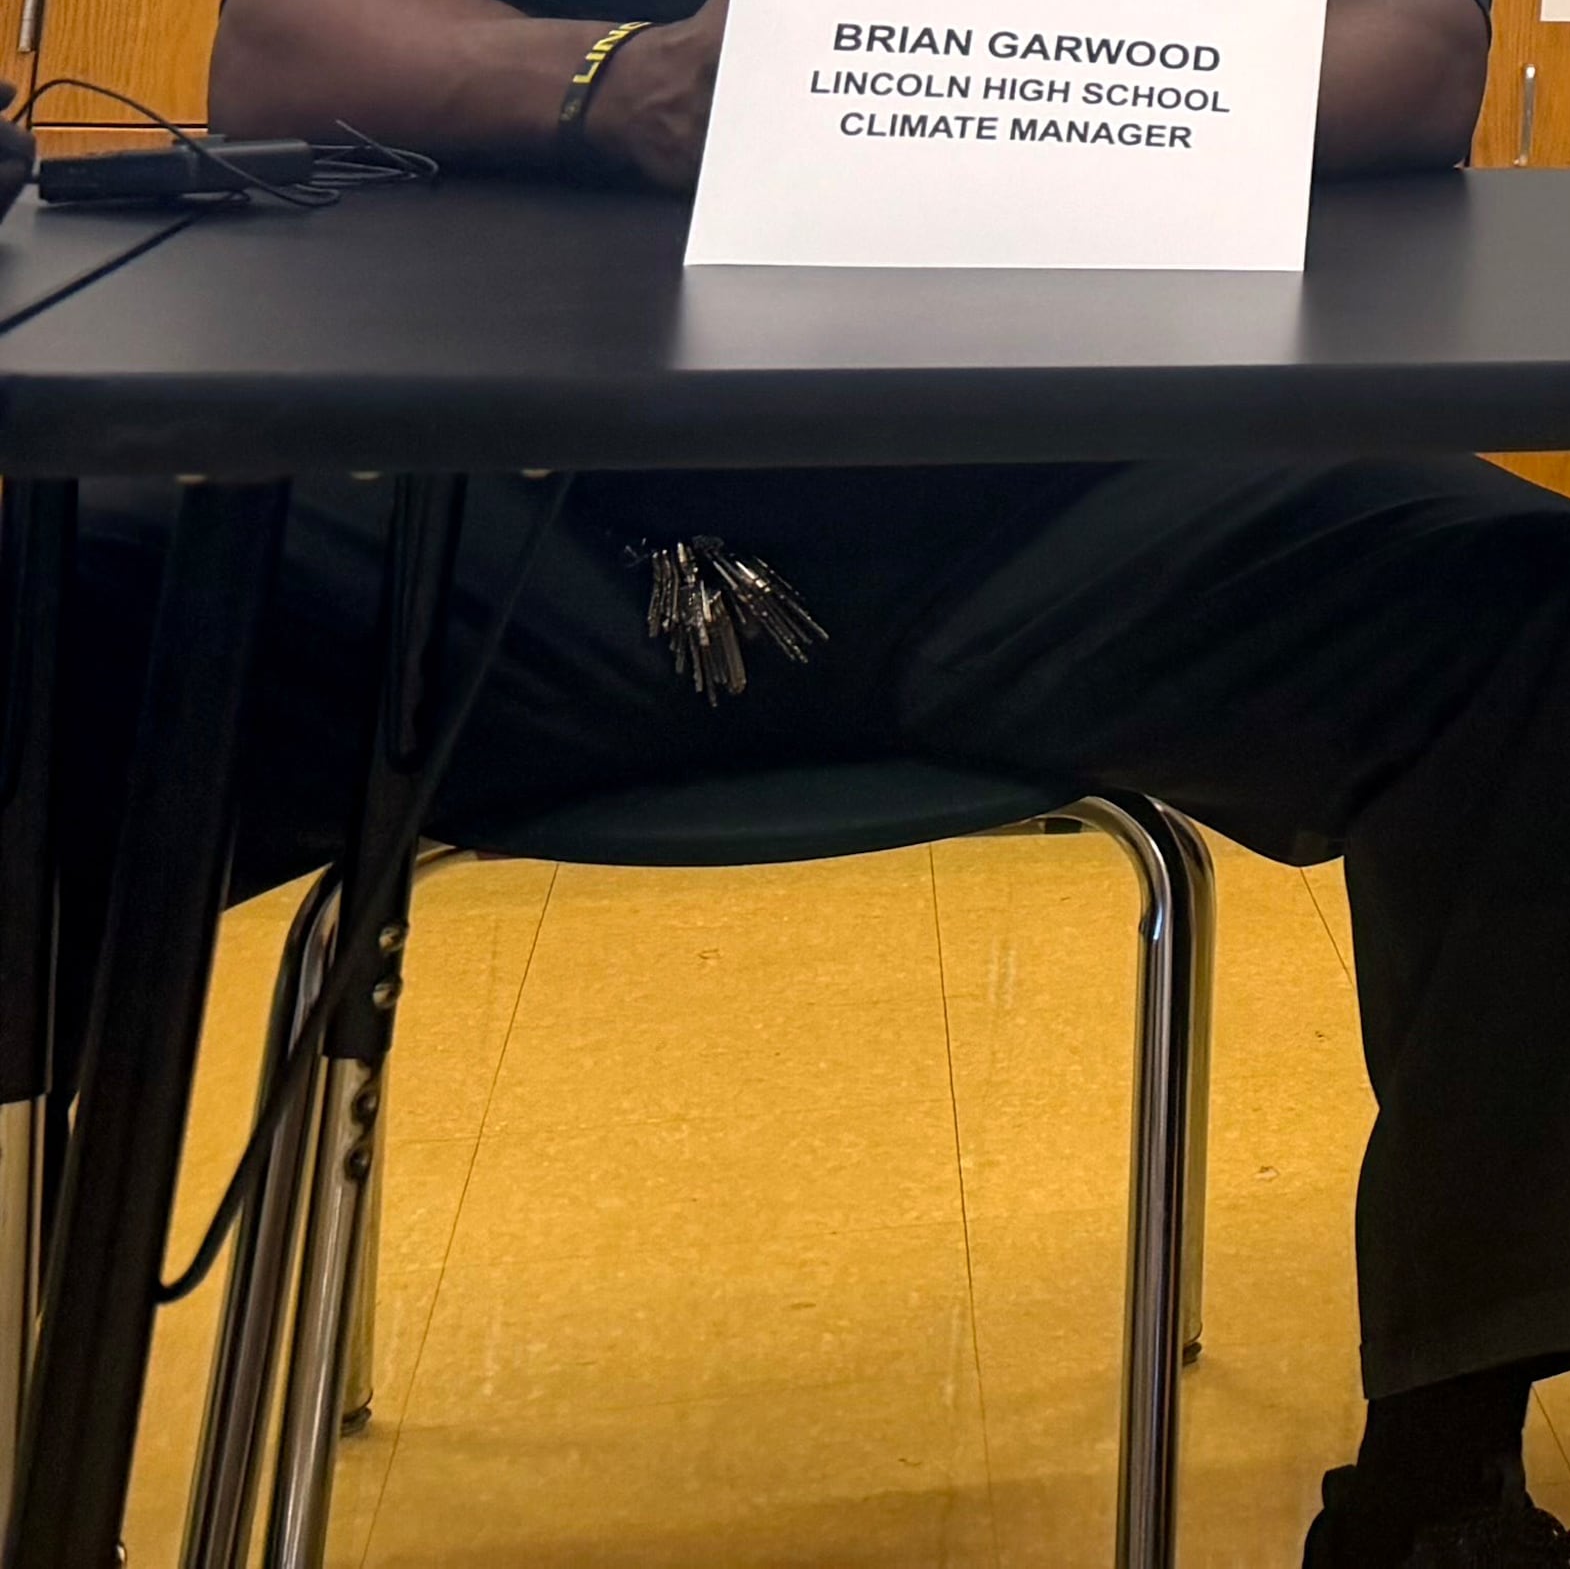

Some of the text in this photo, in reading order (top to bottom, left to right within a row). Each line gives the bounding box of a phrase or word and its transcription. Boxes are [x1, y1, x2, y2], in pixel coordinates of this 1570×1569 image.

[833, 23, 1221, 72] BRIAN GARWOOD
[810, 70, 1230, 113] LINCOLN HIGH SCHOOL
[840, 112, 1192, 149] CLIMATE MANAGER
